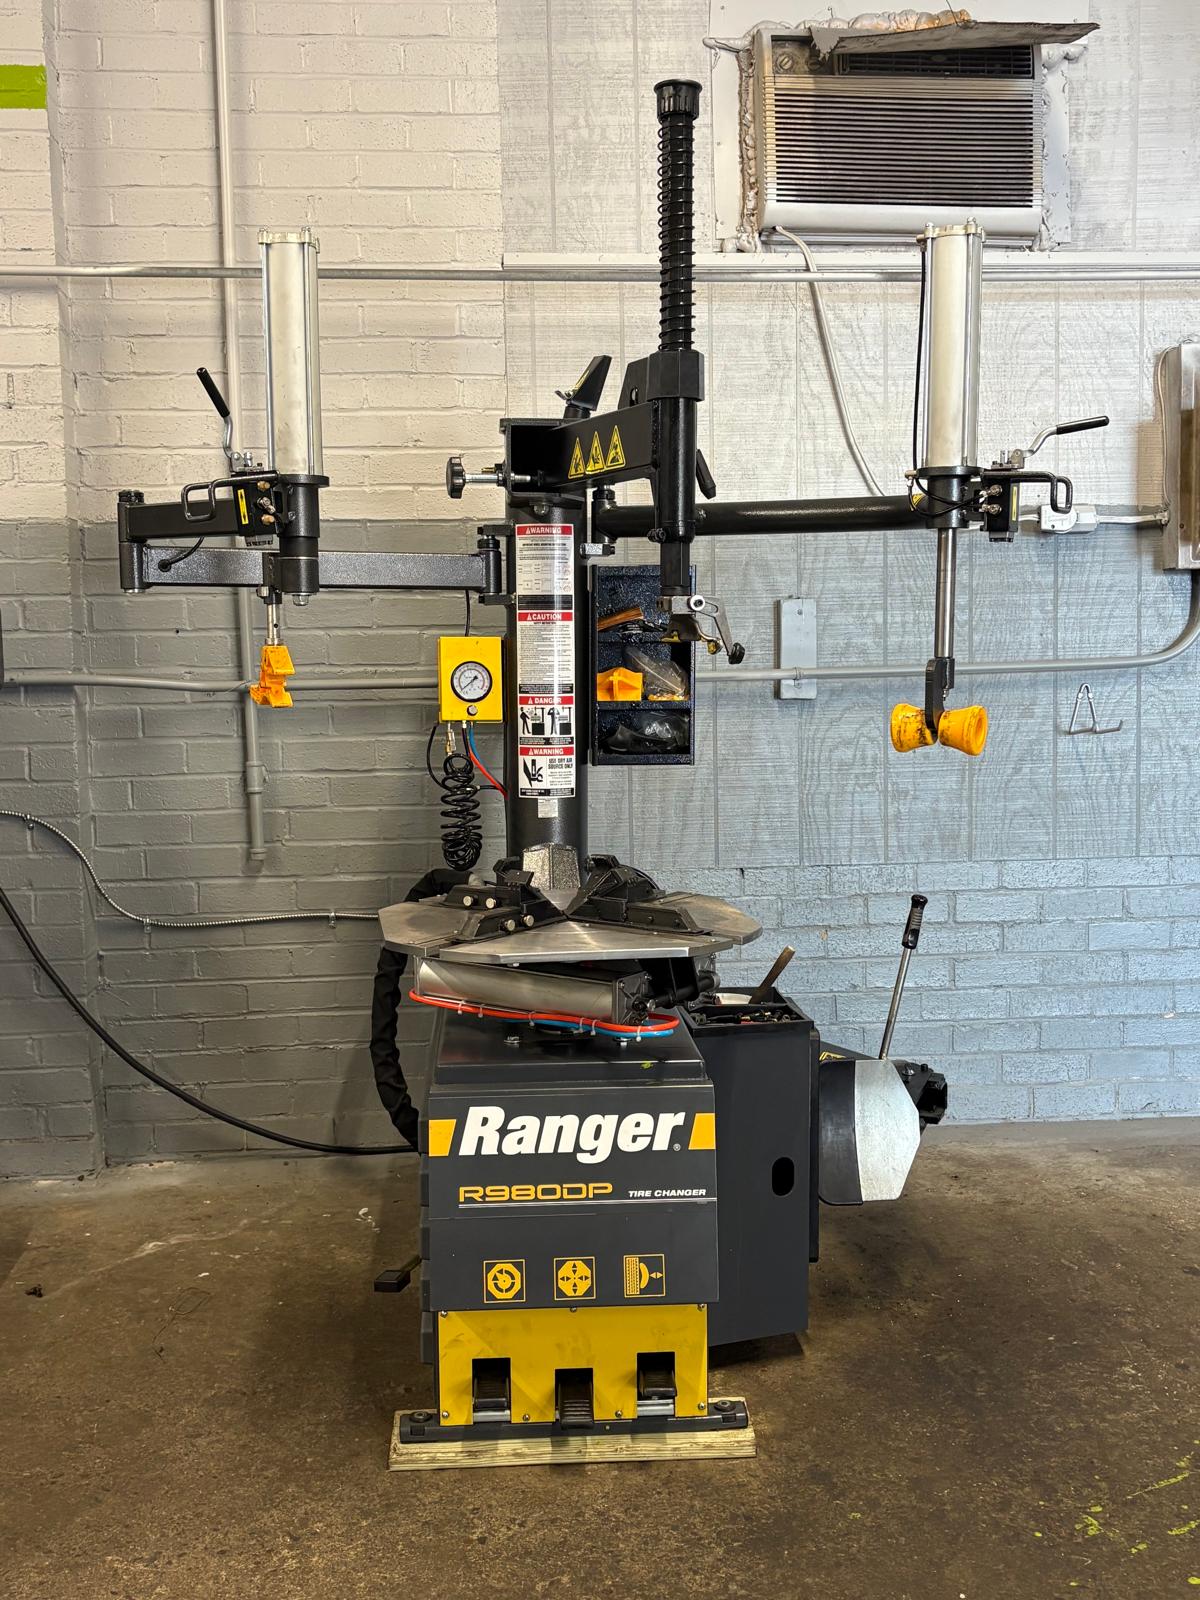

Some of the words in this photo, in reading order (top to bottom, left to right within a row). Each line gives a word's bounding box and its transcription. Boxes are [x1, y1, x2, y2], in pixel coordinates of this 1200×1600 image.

[530, 526, 562, 534] WARNING
[459, 1106, 686, 1165] Ranger
[459, 1182, 613, 1203] R980DP
[628, 1189, 652, 1198] TIRE
[653, 1188, 707, 1197] CHANGER
